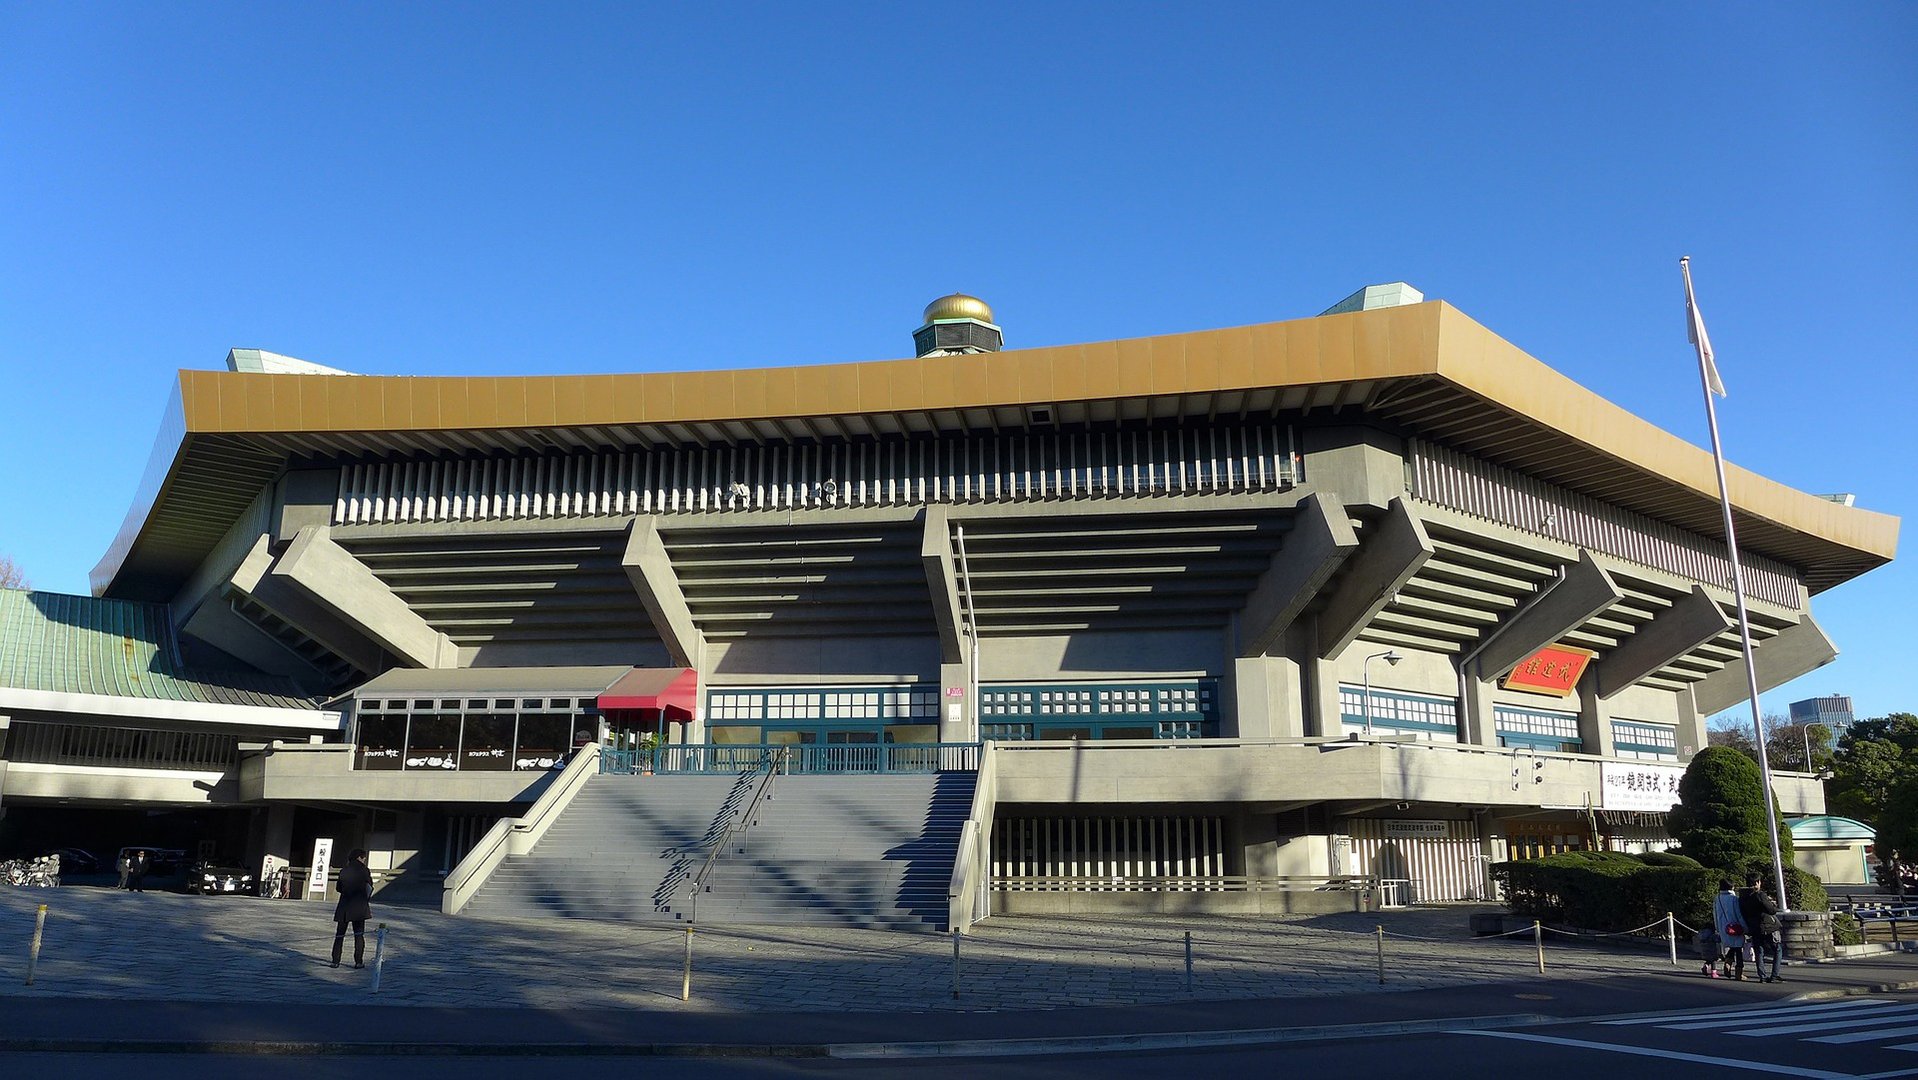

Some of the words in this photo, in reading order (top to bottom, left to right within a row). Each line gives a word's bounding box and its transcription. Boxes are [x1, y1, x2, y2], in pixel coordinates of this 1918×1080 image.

[315, 843, 327, 880] 一般入場口
